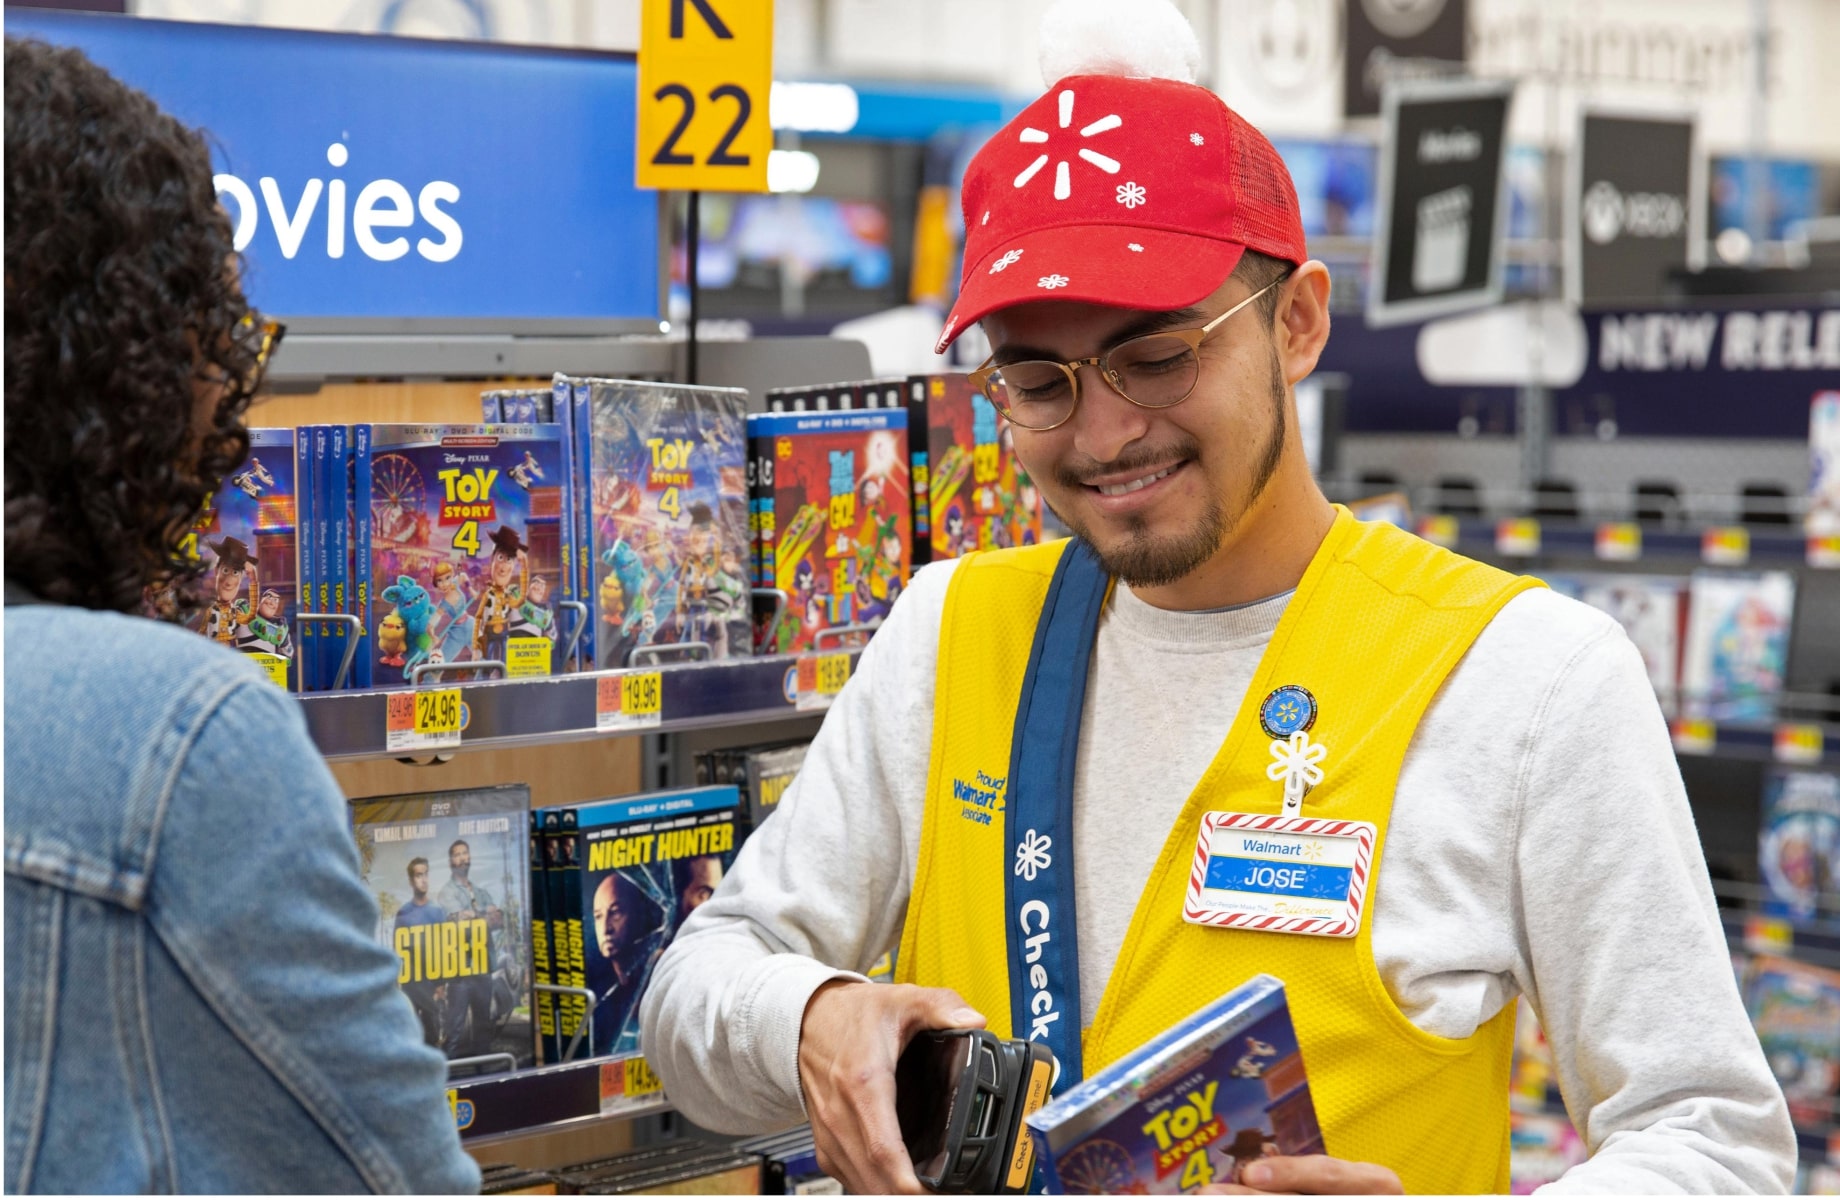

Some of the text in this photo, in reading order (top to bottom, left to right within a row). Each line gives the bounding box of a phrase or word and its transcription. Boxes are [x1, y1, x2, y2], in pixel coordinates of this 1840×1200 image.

[651, 83, 752, 166] 22
[212, 142, 463, 263] ovies
[1599, 312, 1719, 371] NEW
[443, 453, 468, 465] Disney
[646, 437, 695, 470] TOY
[438, 468, 499, 503] TOY
[650, 471, 689, 484] STORY
[444, 505, 492, 518] STORY
[658, 485, 681, 521] 4
[829, 491, 855, 531] GO!
[452, 520, 481, 557] 4
[580, 546, 588, 570] TOY
[303, 582, 313, 607] TOY
[320, 582, 330, 607] TOY
[335, 581, 345, 606] TOY
[358, 580, 368, 606] TOY
[628, 803, 658, 816] BLU-RAY
[665, 798, 694, 810] DIGITAL
[588, 823, 734, 872] NIGHT HUNTER
[1243, 839, 1302, 856] Walmart
[1244, 867, 1307, 889] JOSE
[395, 918, 488, 985] STUBER
[568, 918, 585, 971] NIGHT
[532, 919, 555, 1036] NIGHT HNTER
[553, 920, 575, 1036] NIGHT HNTER
[1020, 900, 1060, 1042] Check
[1015, 1139, 1028, 1170] Check
[1033, 1079, 1043, 1098] me!
[1142, 1080, 1219, 1150] TOY
[1160, 1122, 1219, 1168] STORY
[1180, 1148, 1214, 1190] 4
